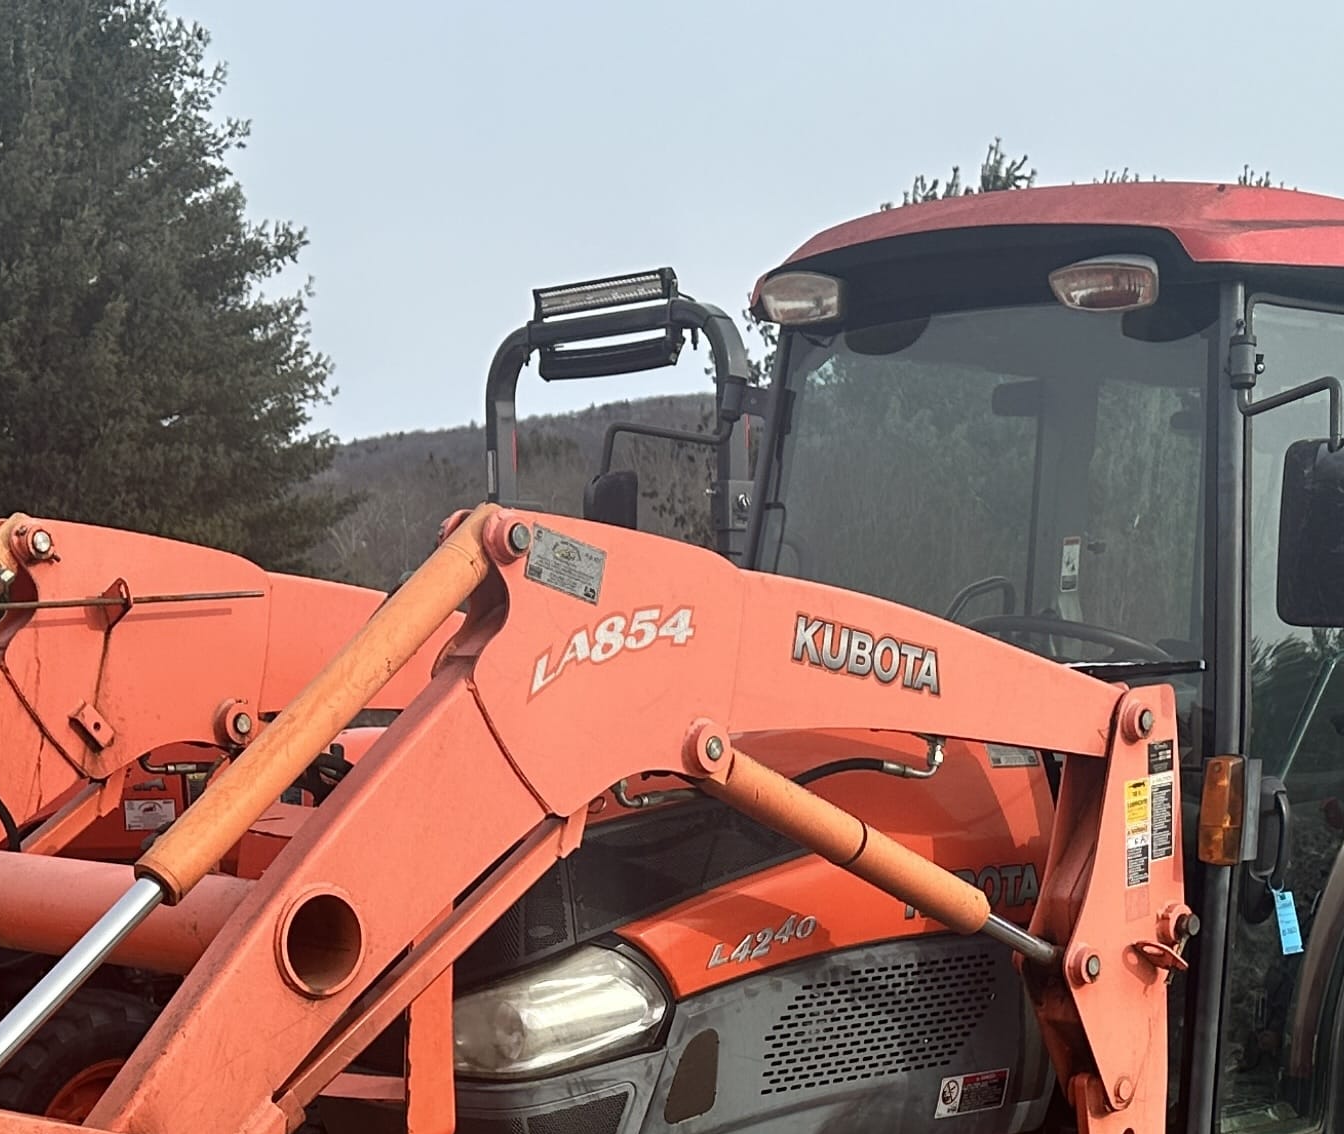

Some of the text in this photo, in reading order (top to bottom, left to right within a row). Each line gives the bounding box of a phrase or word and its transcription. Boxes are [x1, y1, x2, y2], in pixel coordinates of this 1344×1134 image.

[529, 606, 695, 697] LA854
[791, 614, 941, 695] KUBOTA
[707, 913, 816, 969] L4240
